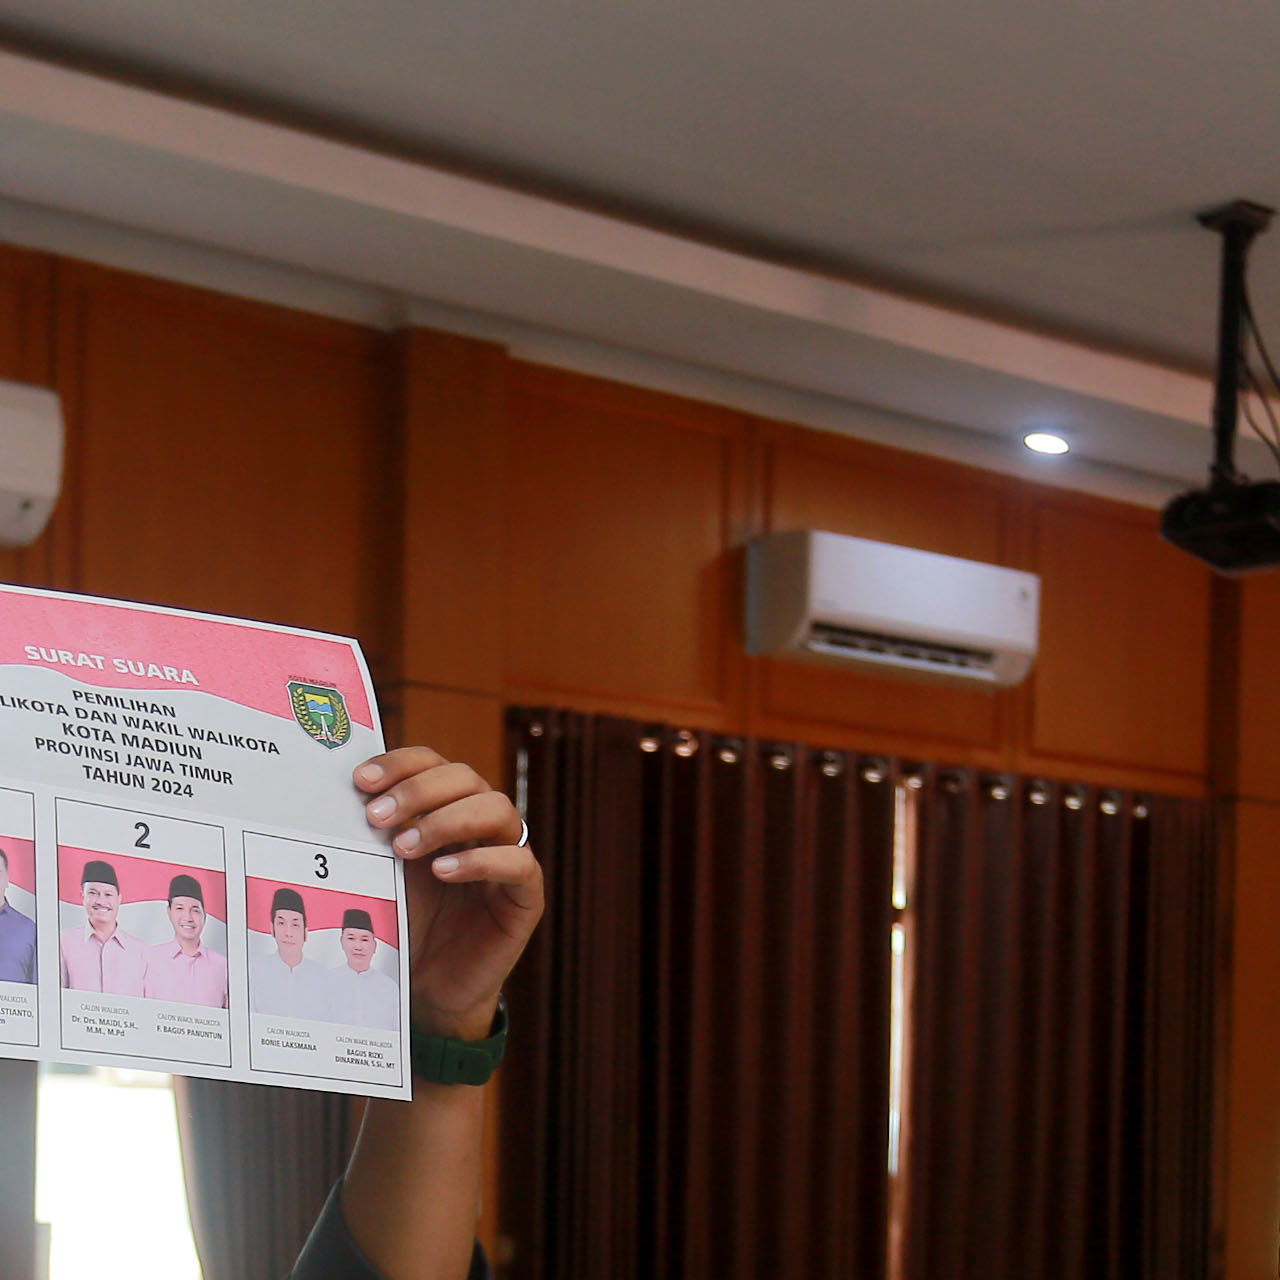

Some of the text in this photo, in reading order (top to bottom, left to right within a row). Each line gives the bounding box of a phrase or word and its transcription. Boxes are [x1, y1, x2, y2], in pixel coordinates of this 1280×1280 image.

[24, 645, 199, 686] SURAT SUARA
[72, 690, 176, 718] PEMILIHAN
[62, 723, 202, 760] KOTA MADIUN
[75, 707, 118, 725] DAN
[122, 715, 183, 737] WAKIL
[187, 726, 280, 755] WALIKOTA
[35, 737, 233, 785] PROVINSI JAWA TIMUR
[83, 765, 194, 798] TAHUN 2024
[134, 822, 152, 850] 2
[314, 853, 330, 880] 3
[72, 1016, 82, 1024] Dr.
[84, 1017, 97, 1025] Drs.
[81, 1004, 129, 1016] CALON WALIKOTA
[108, 1029, 125, 1037] M.Pd
[164, 1026, 185, 1035] BAGUS
[187, 1029, 222, 1040] PANUNTUN
[261, 1039, 317, 1051] BONIE LAKSMANA
[347, 1049, 367, 1058] BAGUS
